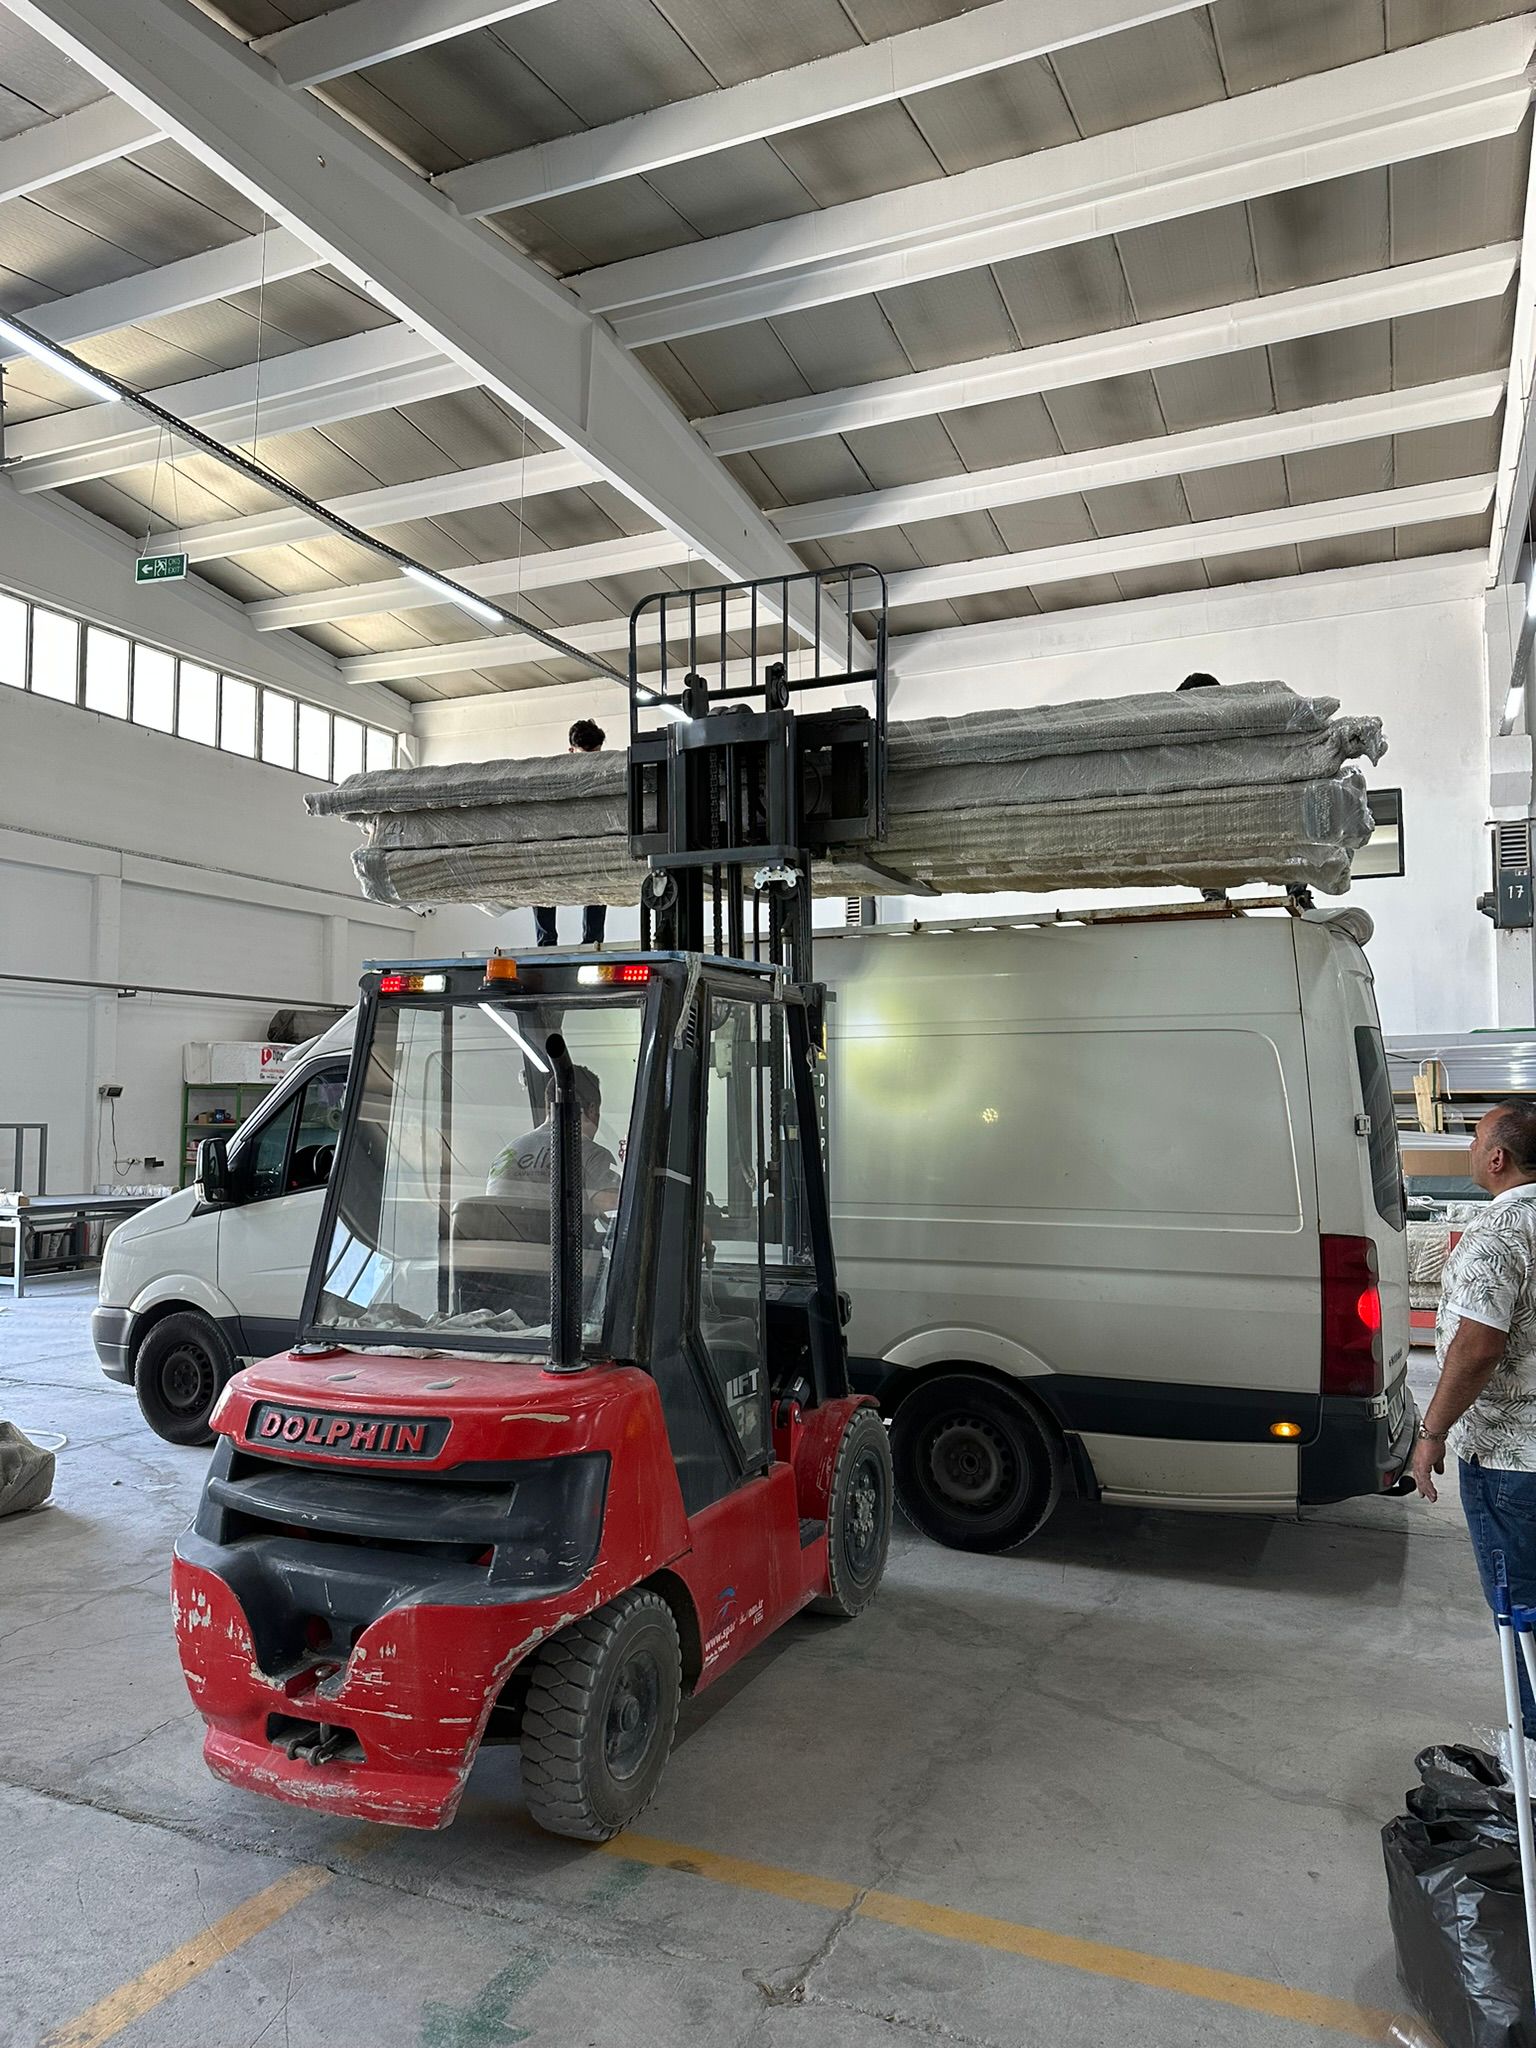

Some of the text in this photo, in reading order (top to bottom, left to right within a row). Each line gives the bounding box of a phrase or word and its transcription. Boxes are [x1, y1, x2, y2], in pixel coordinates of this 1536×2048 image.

[1508, 885, 1524, 899] 17
[517, 1146, 551, 1169] eli
[726, 1367, 760, 1408] LIFT
[260, 1412, 428, 1453] DOLPHIN
